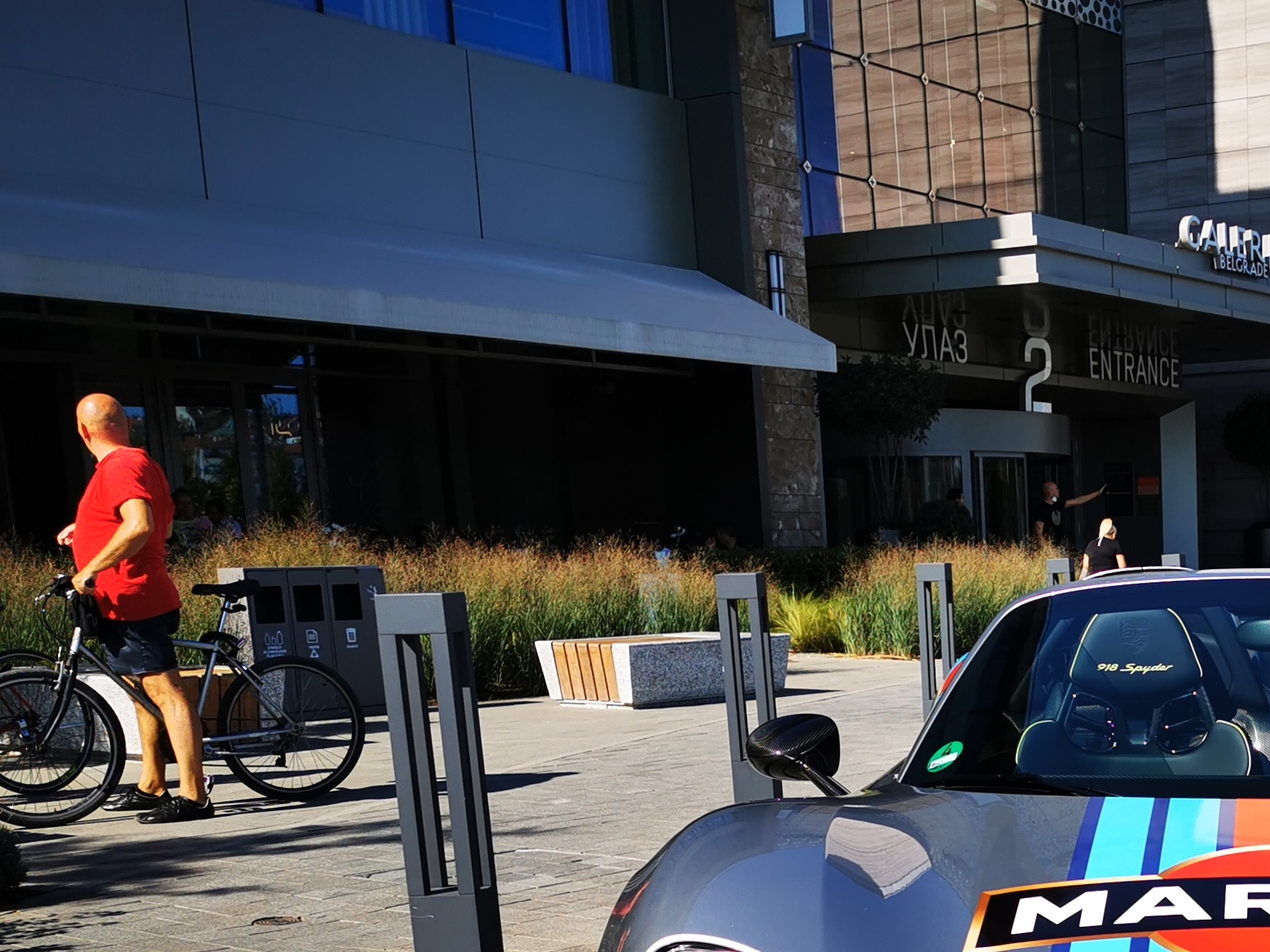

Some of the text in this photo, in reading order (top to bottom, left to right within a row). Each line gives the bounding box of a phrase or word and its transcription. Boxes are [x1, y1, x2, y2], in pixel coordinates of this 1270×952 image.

[1220, 254, 1268, 278] BELGRADE
[902, 322, 968, 364] УЛАЗ
[1024, 337, 1052, 413] 2
[1089, 348, 1180, 388] ENTRANCE
[1097, 663, 1173, 675] 918 Spyder
